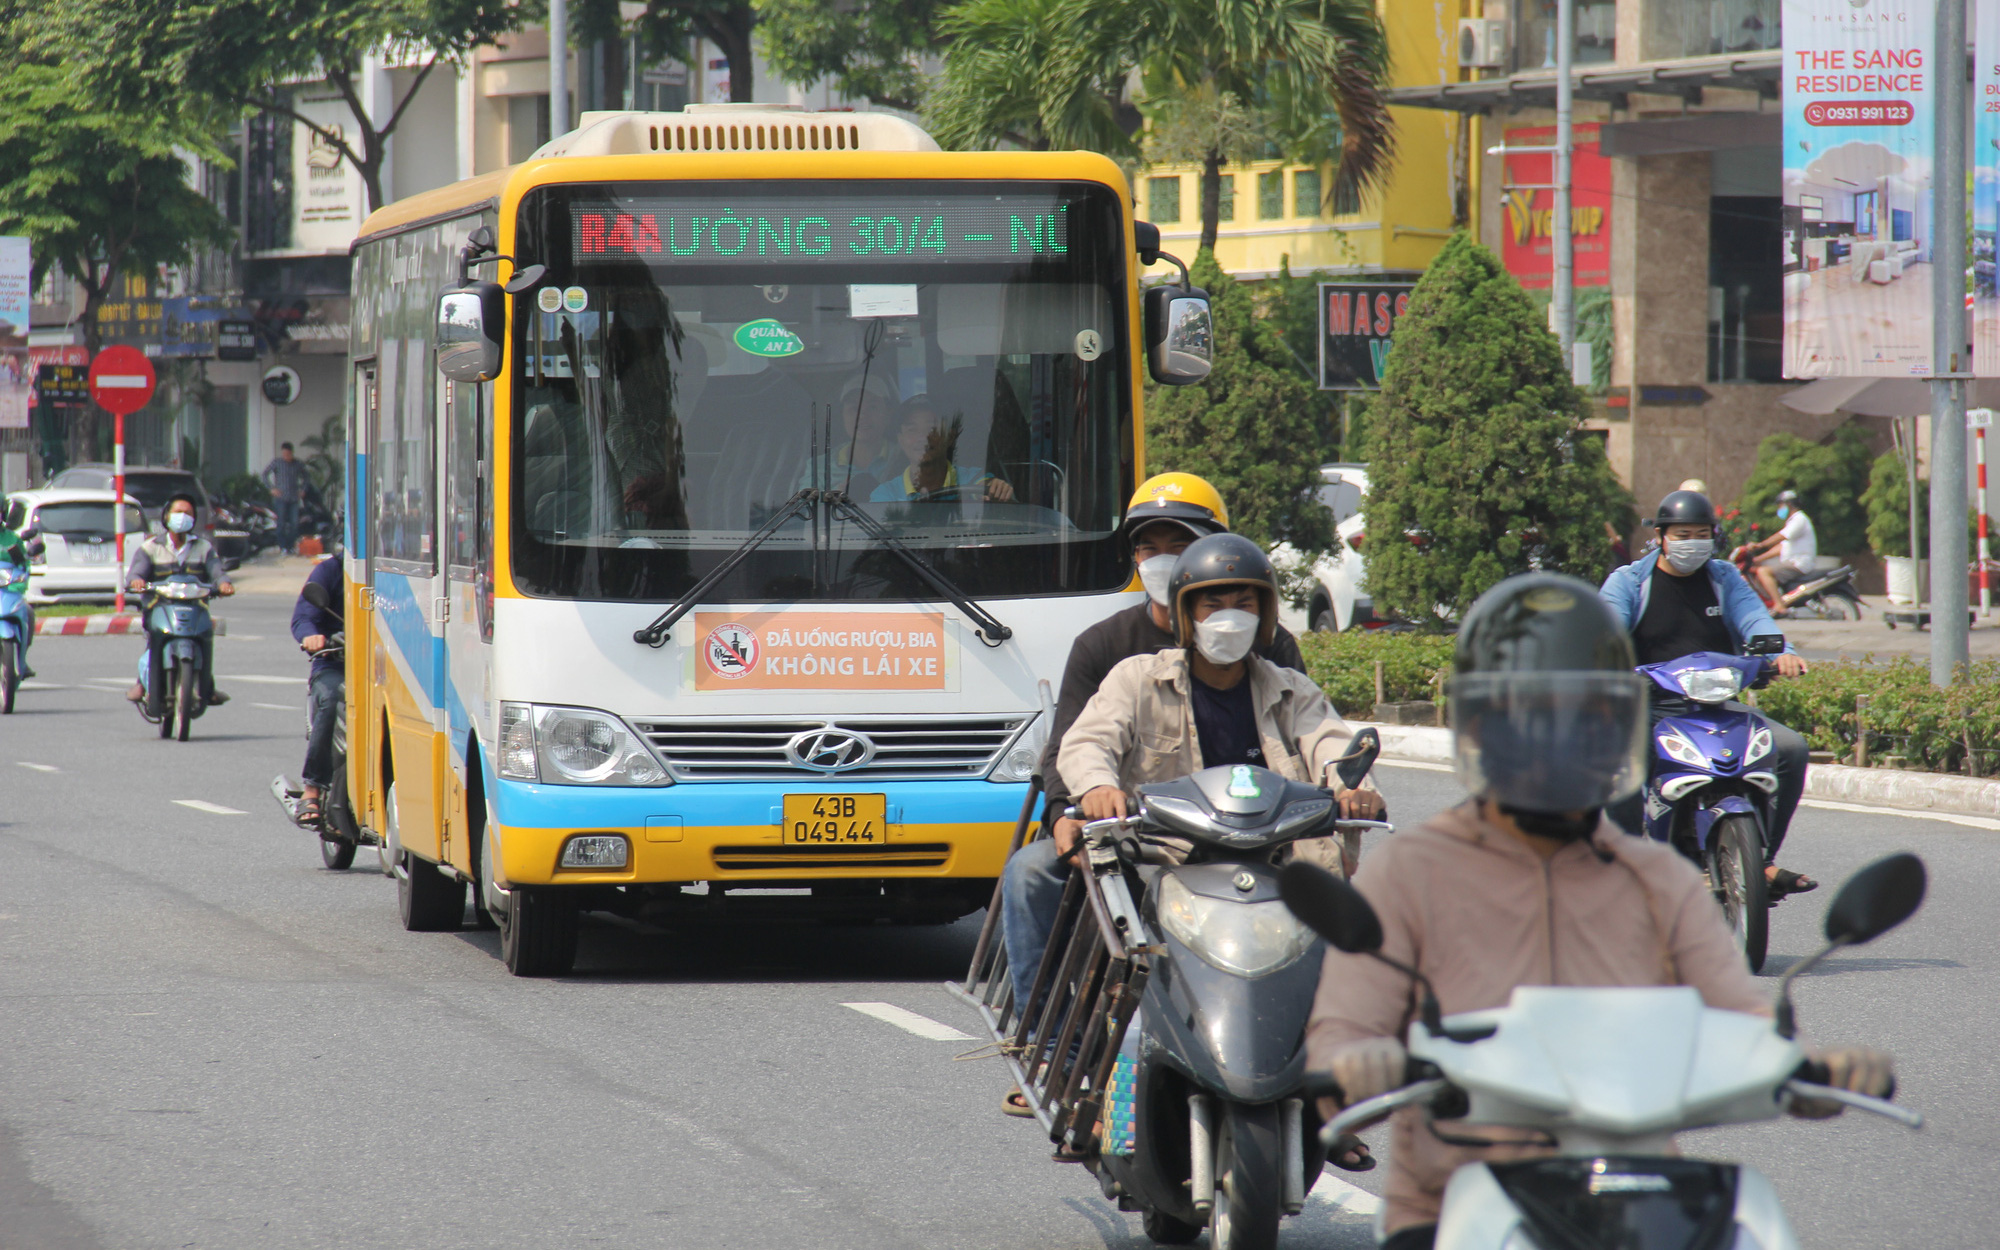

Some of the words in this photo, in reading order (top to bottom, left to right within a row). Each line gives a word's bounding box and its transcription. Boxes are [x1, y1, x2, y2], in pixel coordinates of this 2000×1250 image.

[1850, 12, 1907, 23] SANG
[1795, 50, 1845, 70] THE
[1852, 48, 1923, 69] SANG
[1796, 74, 1923, 93] RESIDENCE
[1827, 107, 1858, 120] 0931
[1861, 107, 1884, 119] 991
[1886, 107, 1908, 119] 123
[849, 216, 947, 255] 30/4
[764, 342, 783, 352] AN
[784, 342, 793, 352] 1
[766, 628, 792, 647] ĐÃ
[796, 627, 848, 647] UỐNG
[850, 629, 906, 651] RƯỢU,
[908, 632, 937, 648] BIA
[766, 653, 854, 676] KHÔNG
[862, 653, 900, 676] LÁI
[908, 657, 937, 676] XE
[812, 796, 856, 818] 43B
[794, 820, 874, 842] 049.44
